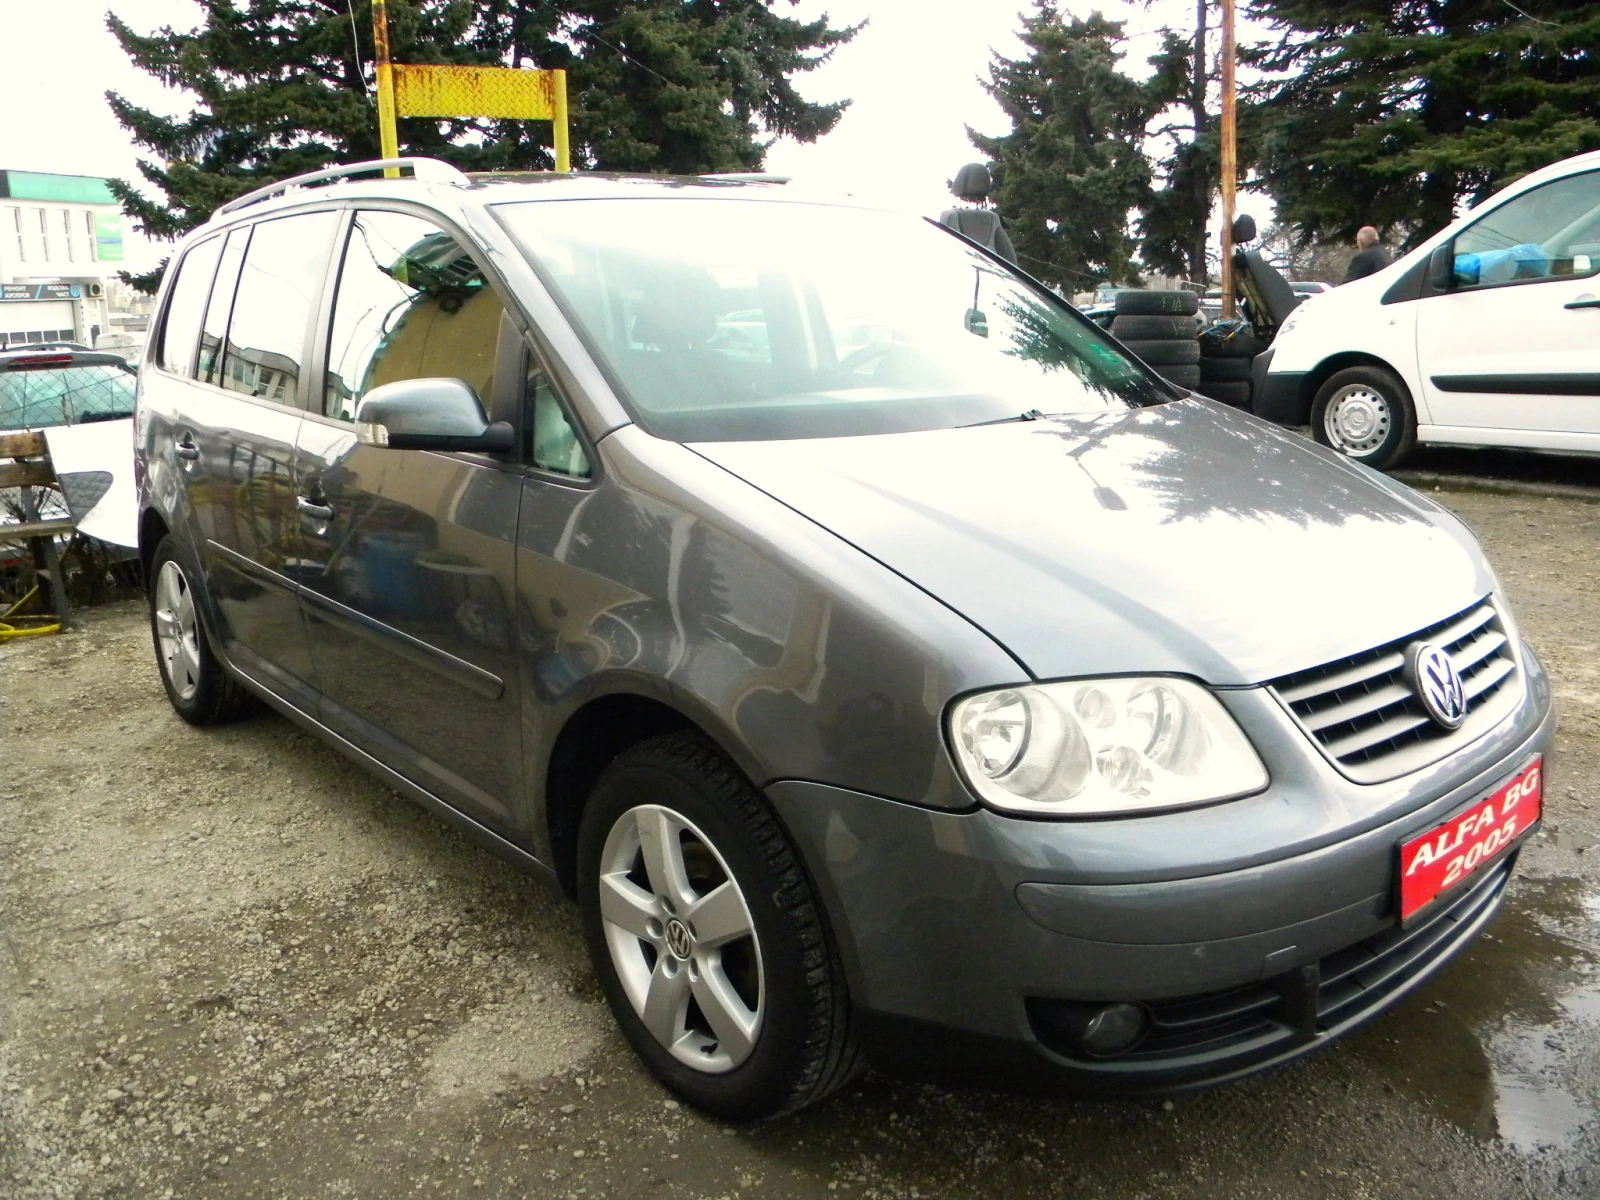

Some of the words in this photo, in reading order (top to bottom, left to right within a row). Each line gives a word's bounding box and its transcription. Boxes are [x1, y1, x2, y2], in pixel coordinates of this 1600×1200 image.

[1405, 805, 1494, 876] ALFA
[1501, 768, 1539, 815] BG
[1441, 815, 1517, 887] 2005
